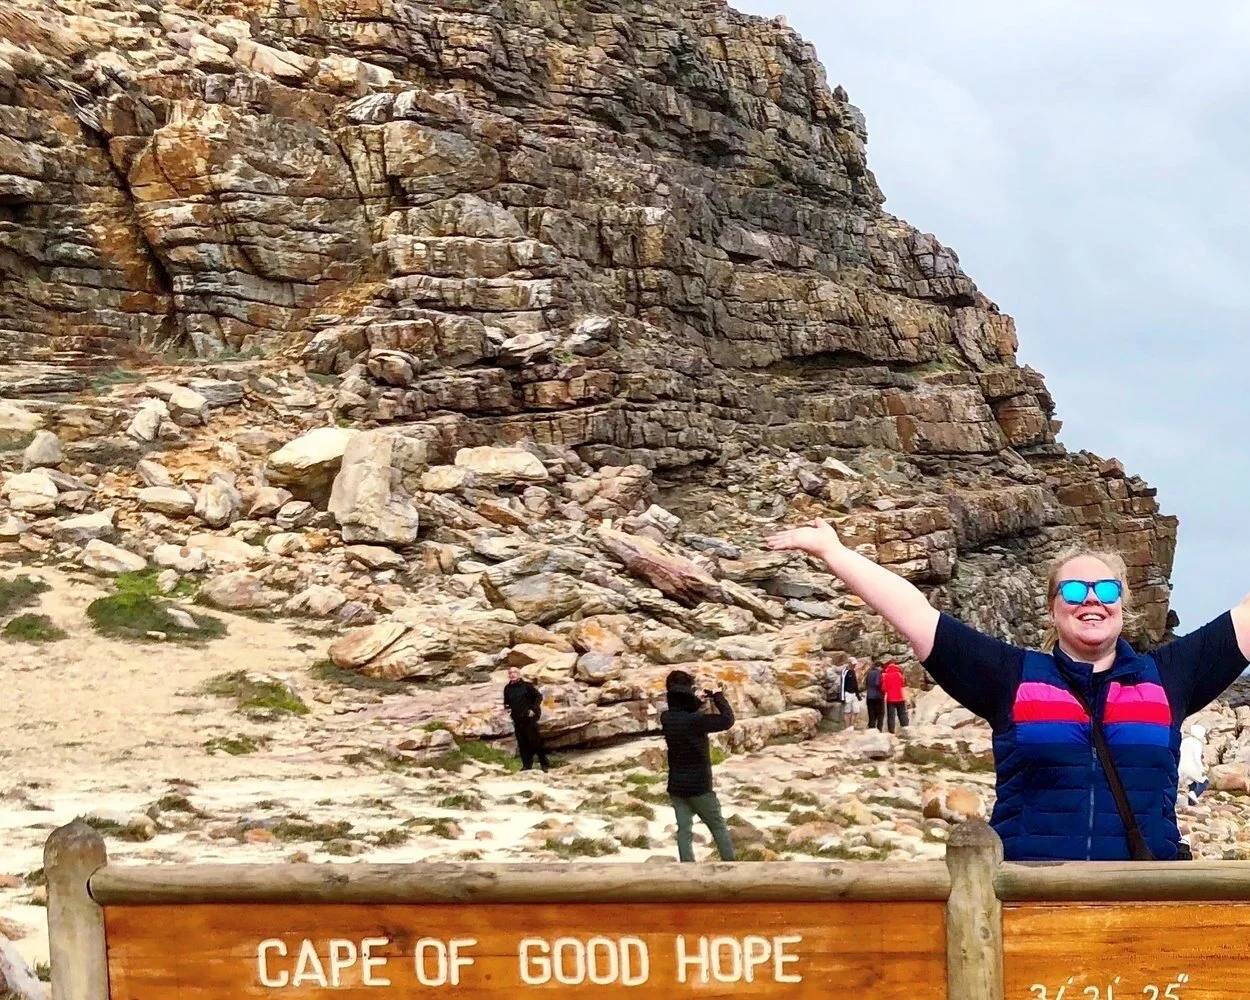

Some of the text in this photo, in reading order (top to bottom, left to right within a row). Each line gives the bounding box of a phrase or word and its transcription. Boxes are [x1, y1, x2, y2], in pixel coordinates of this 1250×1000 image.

[257, 934, 802, 988] CAPE OF GOOD HOPE
